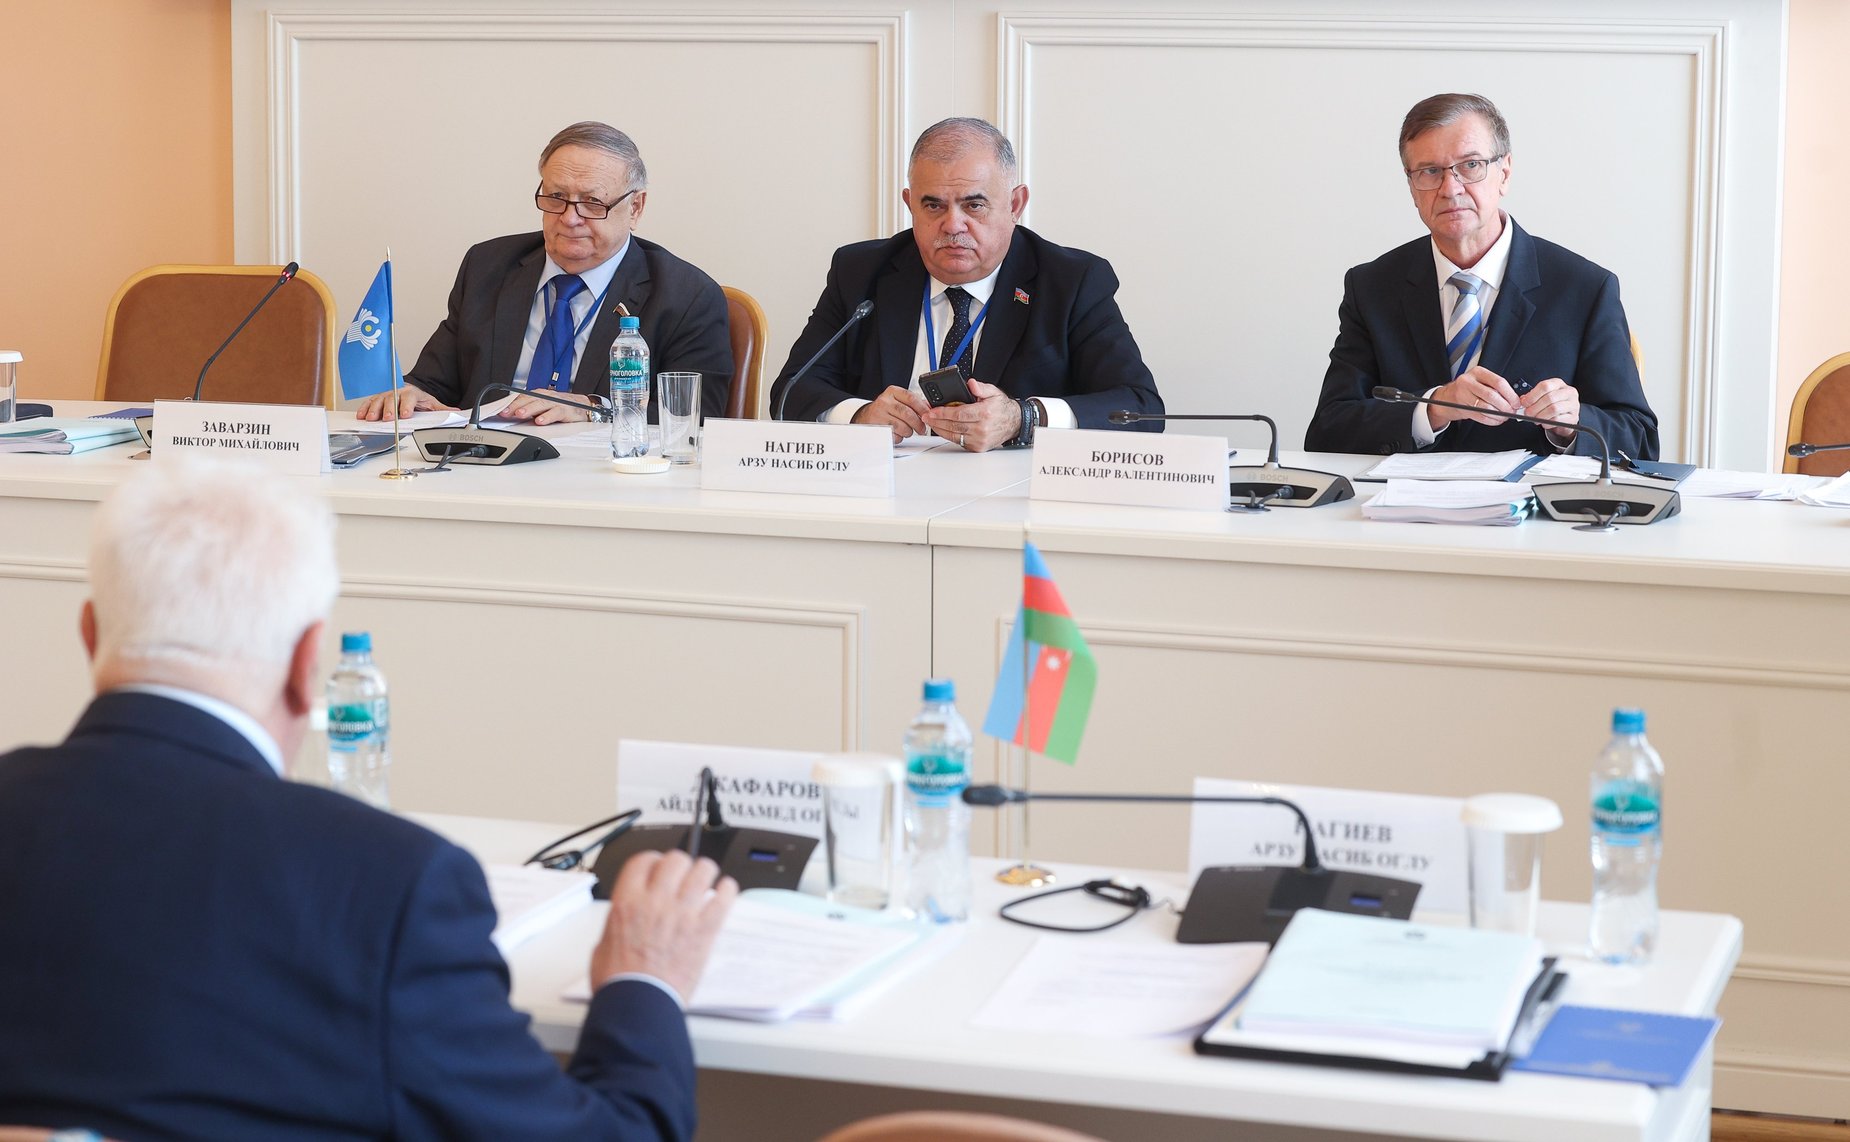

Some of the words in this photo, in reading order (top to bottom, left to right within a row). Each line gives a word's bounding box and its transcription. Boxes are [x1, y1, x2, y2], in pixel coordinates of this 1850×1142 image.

[202, 421, 270, 435] ЗАВАРЗИН
[172, 436, 216, 447] ВИКТОР
[219, 438, 299, 451] МИХАЙЛОВИЧ
[459, 433, 484, 443] BOSCH
[765, 441, 825, 455] НАГИЕВ
[738, 458, 768, 467] АРЗУ
[771, 459, 813, 470] НАСИБ
[816, 461, 850, 472] ОГЛУ
[1091, 450, 1164, 467] БОРИСОВ
[1039, 465, 1112, 480] АЛЕКСАНДР
[1114, 469, 1216, 485] ВАЛЕНТИНОВИЧ
[690, 775, 821, 799] ЖАФАРОВ
